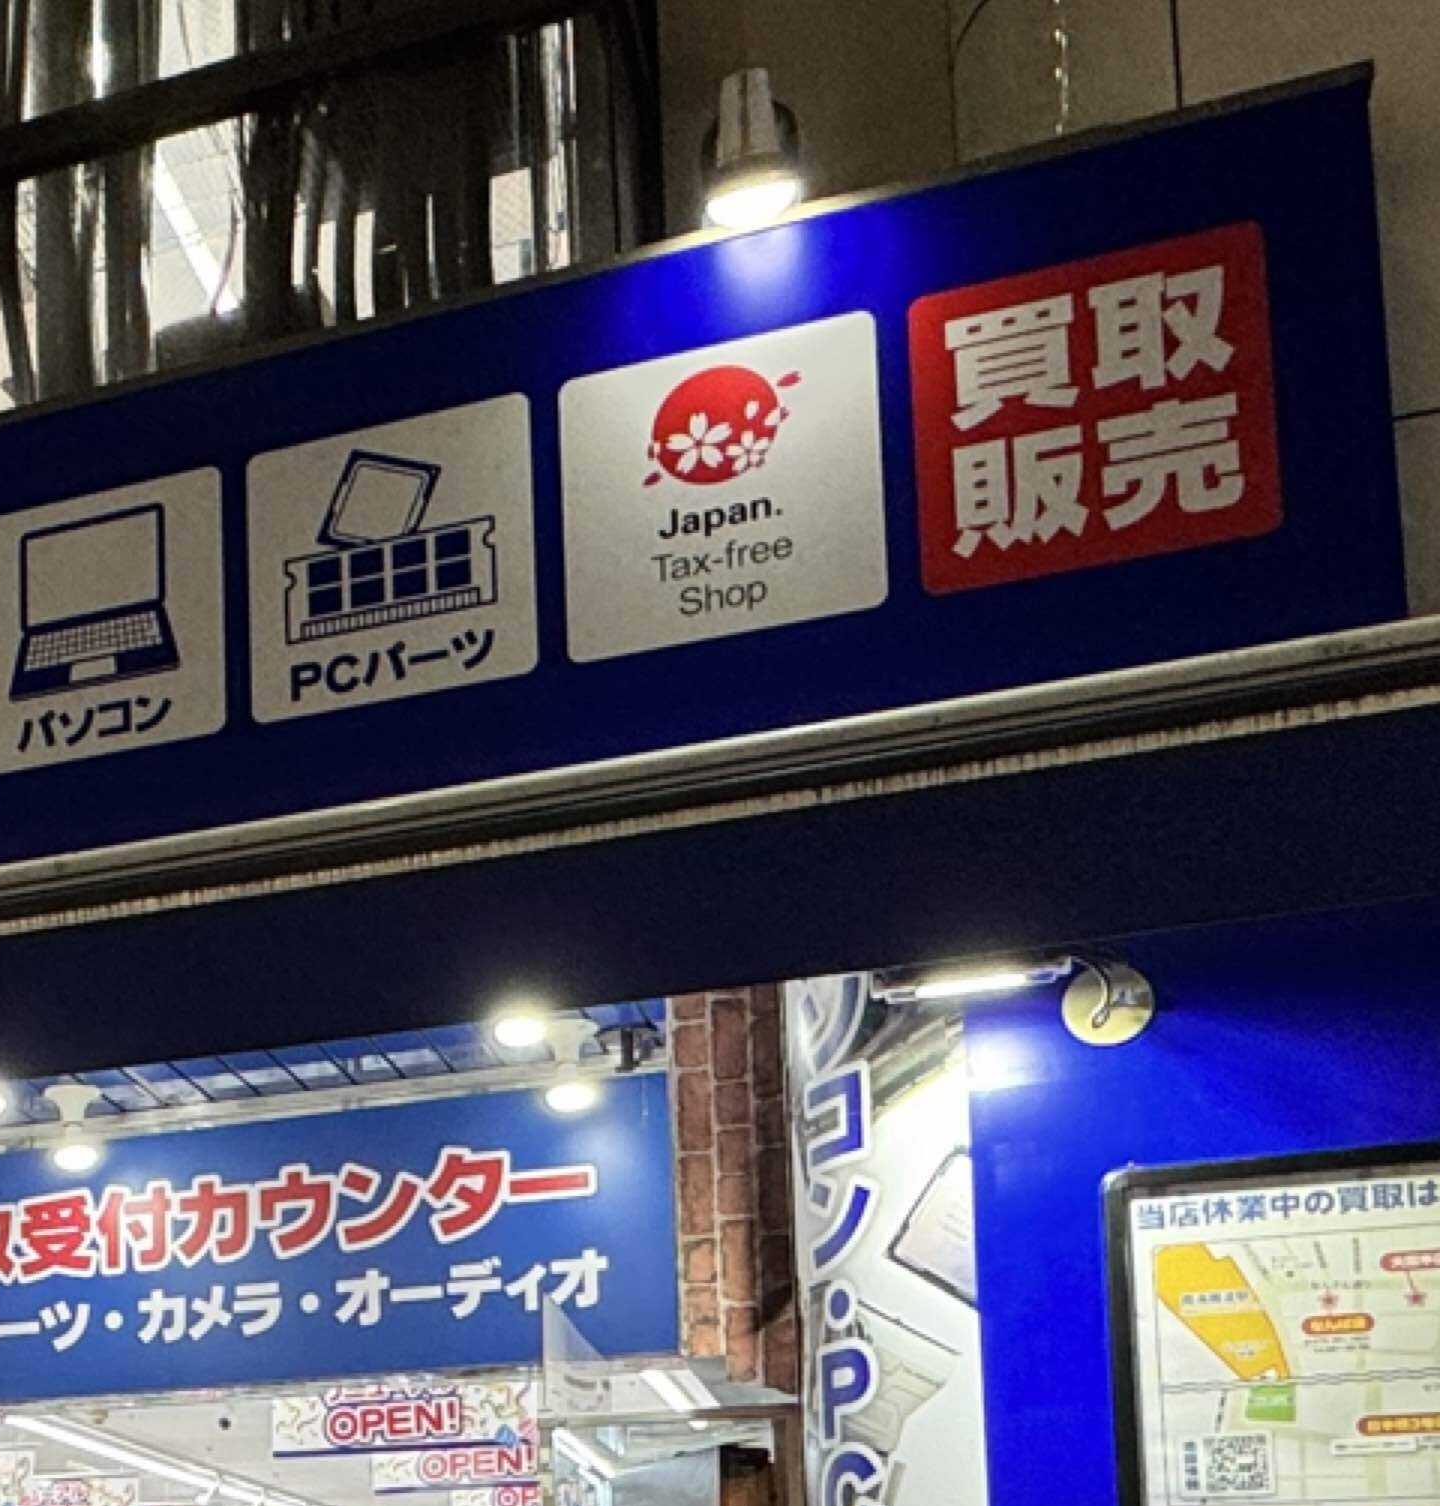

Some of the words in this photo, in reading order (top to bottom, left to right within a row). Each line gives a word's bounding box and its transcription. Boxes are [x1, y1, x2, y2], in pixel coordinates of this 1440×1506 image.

[944, 265, 1235, 430] 買取
[952, 393, 1246, 558] 販売
[658, 498, 784, 541] Japan.
[651, 532, 794, 584] Tax-free
[678, 579, 768, 618] Shop
[290, 628, 495, 700] PCパーツ
[17, 697, 172, 752] パソコン
[327, 1402, 462, 1443] OPEN!
[423, 1446, 536, 1480] OPEN!
